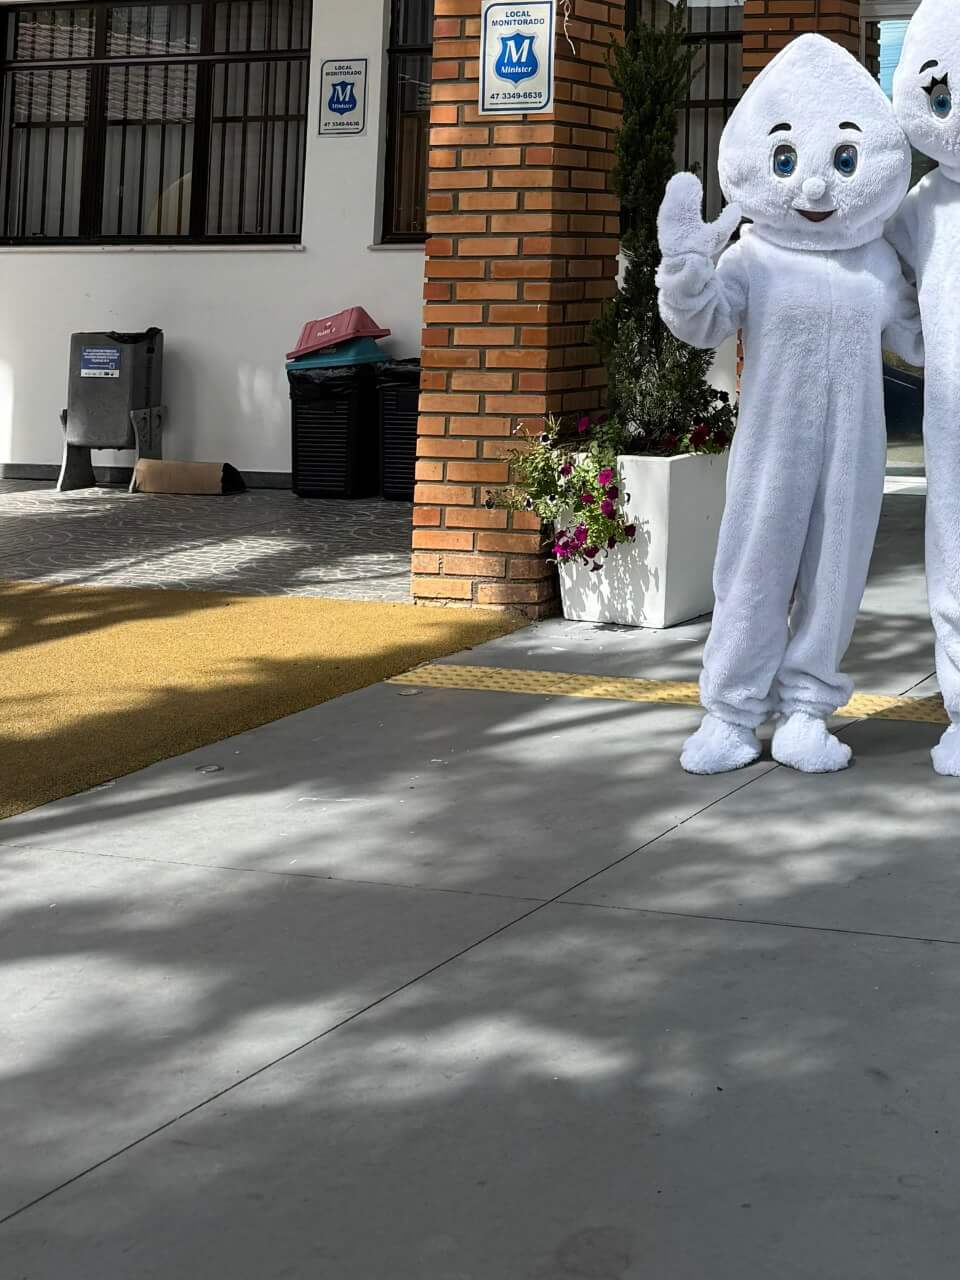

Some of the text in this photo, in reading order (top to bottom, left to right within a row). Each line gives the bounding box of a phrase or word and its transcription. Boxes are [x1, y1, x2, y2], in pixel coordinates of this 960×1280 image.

[505, 10, 531, 18] LOCAL
[491, 18, 545, 27] MONITORADO
[504, 39, 531, 64] M
[500, 66, 533, 74] Minister
[490, 92, 500, 100] 47
